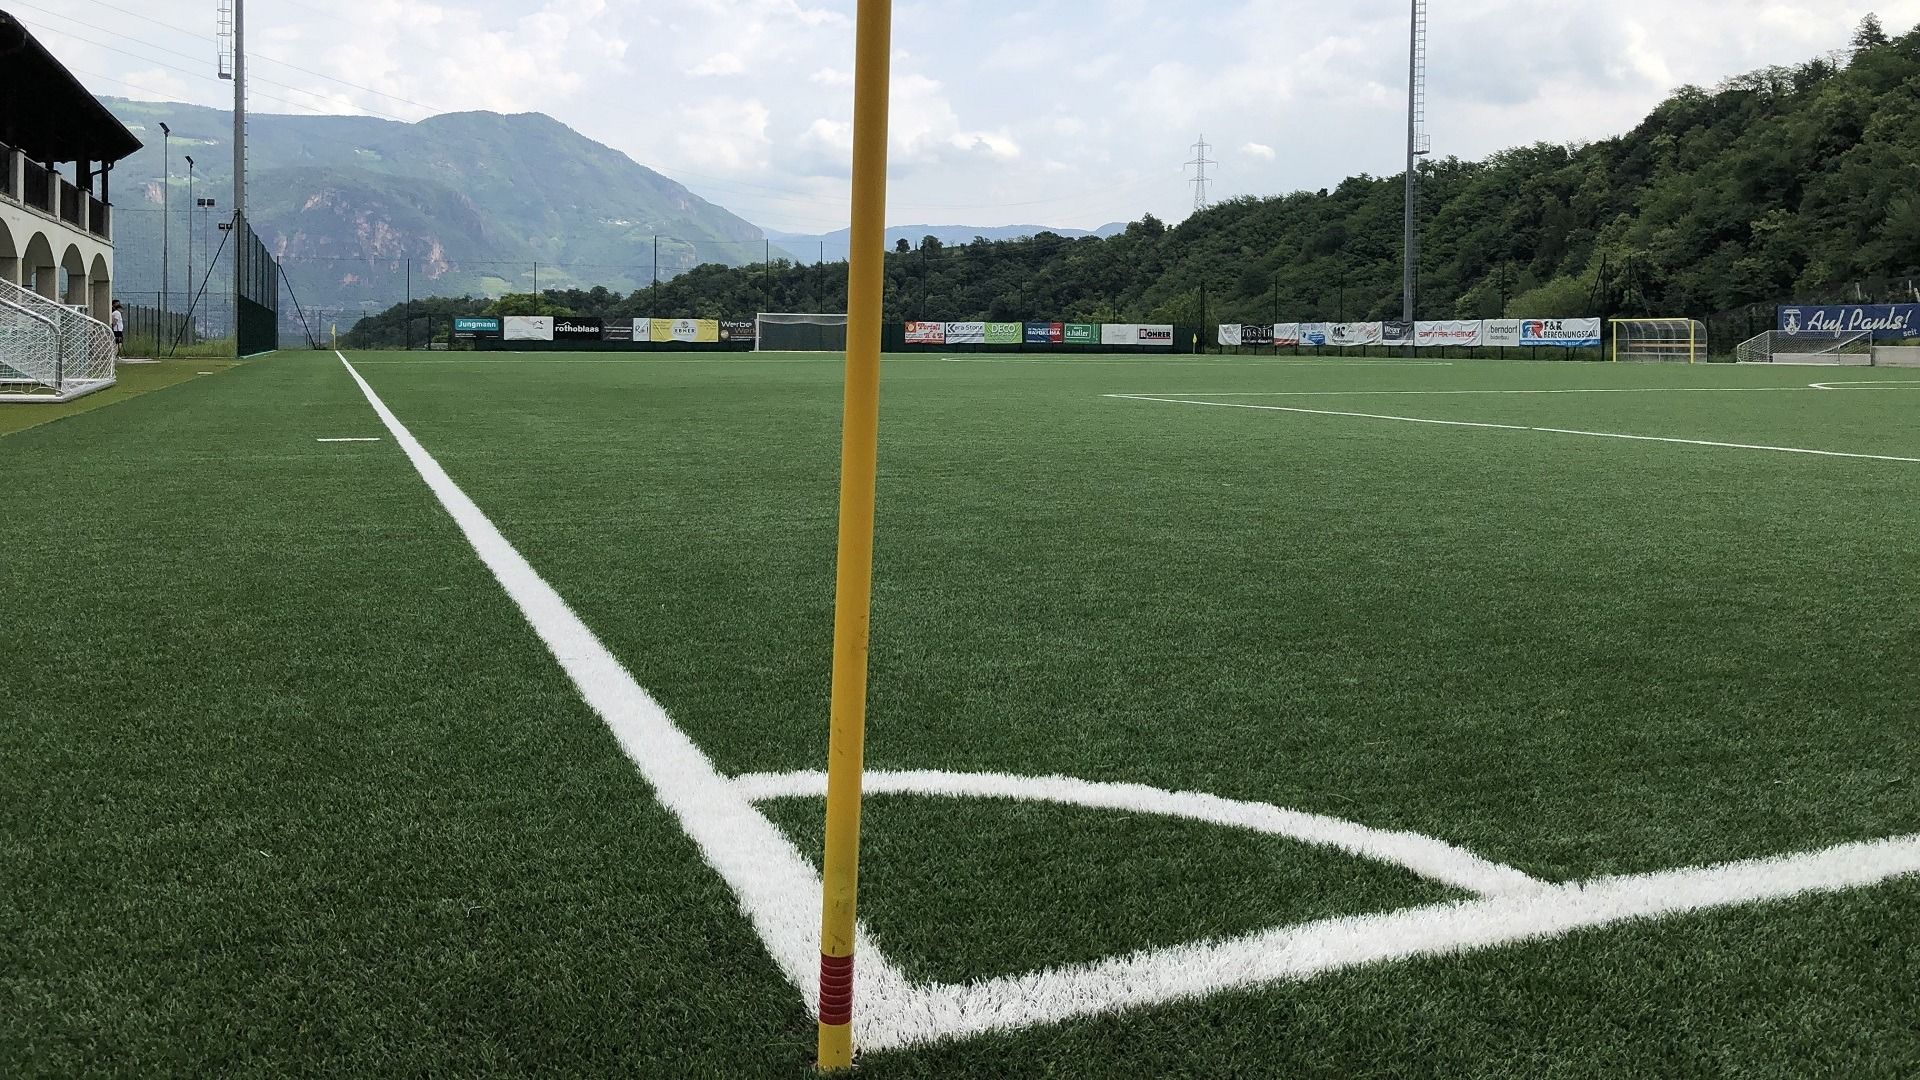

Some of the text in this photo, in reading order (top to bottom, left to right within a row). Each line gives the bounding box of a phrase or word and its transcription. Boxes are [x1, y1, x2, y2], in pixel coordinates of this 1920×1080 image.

[458, 320, 497, 329] Jungmann
[721, 320, 752, 328] Werbe
[1544, 320, 1563, 331] F&R
[1807, 306, 1913, 338] Auf Pauls!
[555, 324, 600, 333] rothoblaas
[992, 324, 1016, 333] DECO
[1490, 324, 1518, 333] berndorf
[1140, 329, 1171, 338] ROHRER
